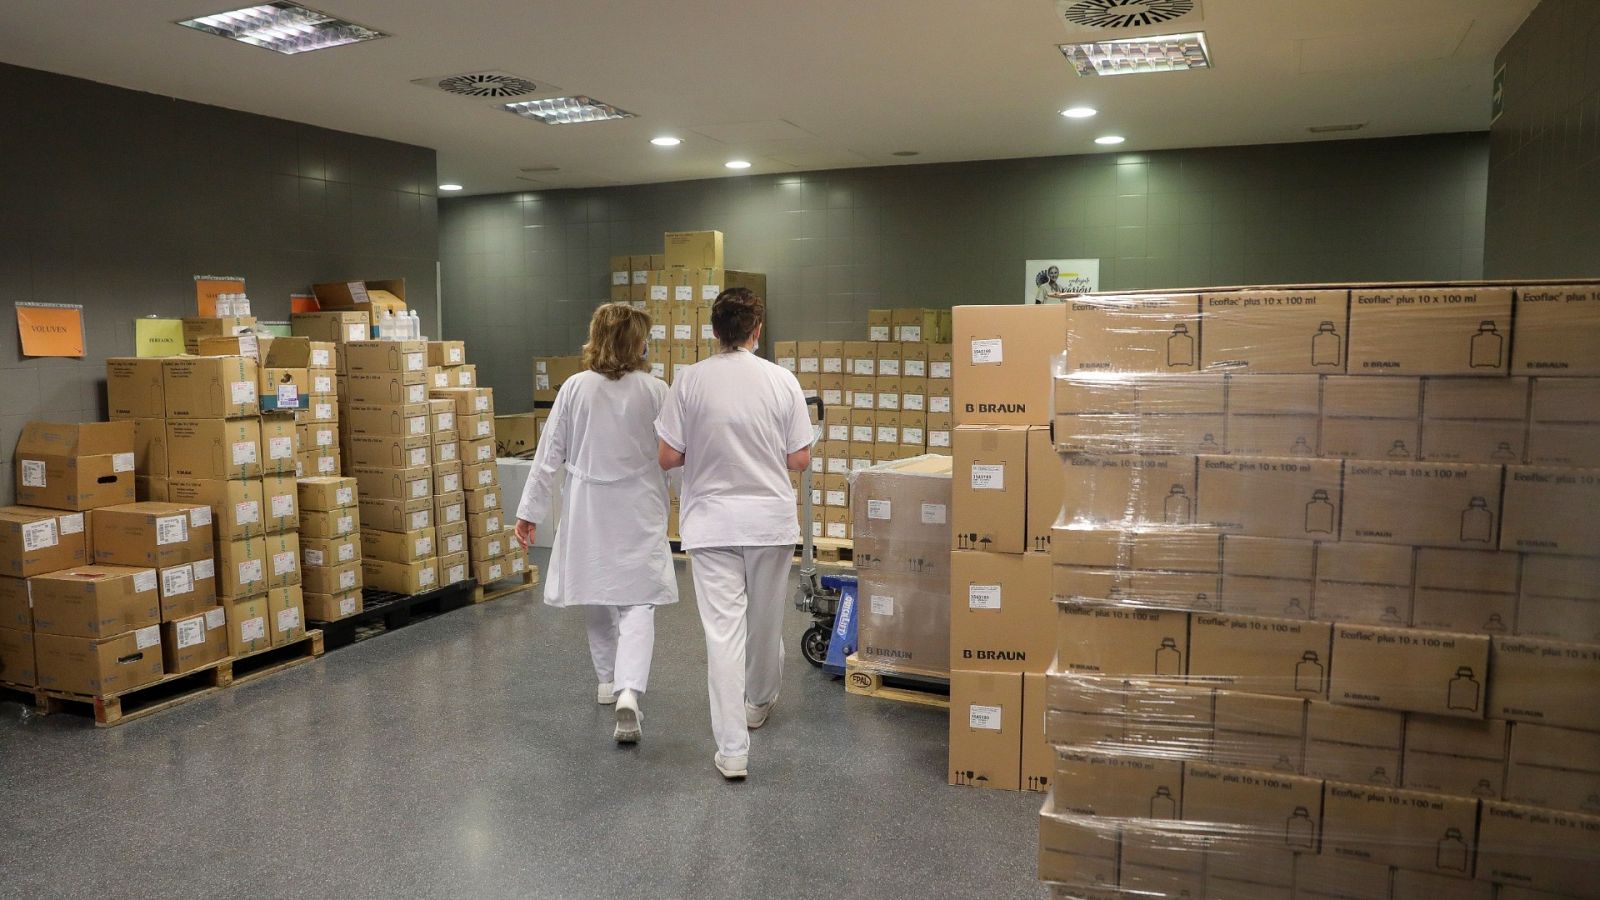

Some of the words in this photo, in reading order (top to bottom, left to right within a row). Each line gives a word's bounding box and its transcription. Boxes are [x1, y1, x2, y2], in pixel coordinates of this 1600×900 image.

[1244, 297, 1260, 307] plus
[1264, 297, 1275, 305] 10
[1286, 297, 1302, 305] 100
[1305, 296, 1316, 304] ml
[1396, 295, 1415, 305] plus
[1419, 295, 1430, 303] 10
[1443, 295, 1461, 303] 100
[1464, 294, 1477, 303] ml
[1566, 292, 1586, 304] plus
[965, 403, 975, 413] B
[978, 403, 1026, 413] BRAUN
[1239, 463, 1255, 472] plus
[1259, 463, 1269, 471] 10
[1280, 464, 1297, 472] 100
[1300, 464, 1311, 472] ml
[1389, 467, 1406, 477] plus
[1410, 468, 1422, 477] 10
[1434, 469, 1451, 478] 100
[1454, 469, 1467, 478] ml
[1113, 611, 1122, 619] 10
[1231, 621, 1247, 629] plus
[1250, 622, 1261, 630] 10
[1271, 623, 1288, 632] 100
[1377, 634, 1396, 643] plus
[1399, 636, 1410, 644] 10
[1422, 639, 1440, 647] 100
[1442, 640, 1455, 648] ml
[876, 647, 913, 660] BRAUN
[963, 649, 972, 659] B
[977, 650, 1026, 661] BRAUN
[1566, 649, 1578, 658] 10
[1242, 776, 1252, 784] 10
[1263, 779, 1279, 788] 100
[1367, 793, 1385, 802] plus
[1388, 796, 1399, 804] 10
[1411, 799, 1429, 808] 100
[1431, 802, 1443, 810] ml
[1530, 814, 1550, 824] plus
[1554, 818, 1566, 826] 10
